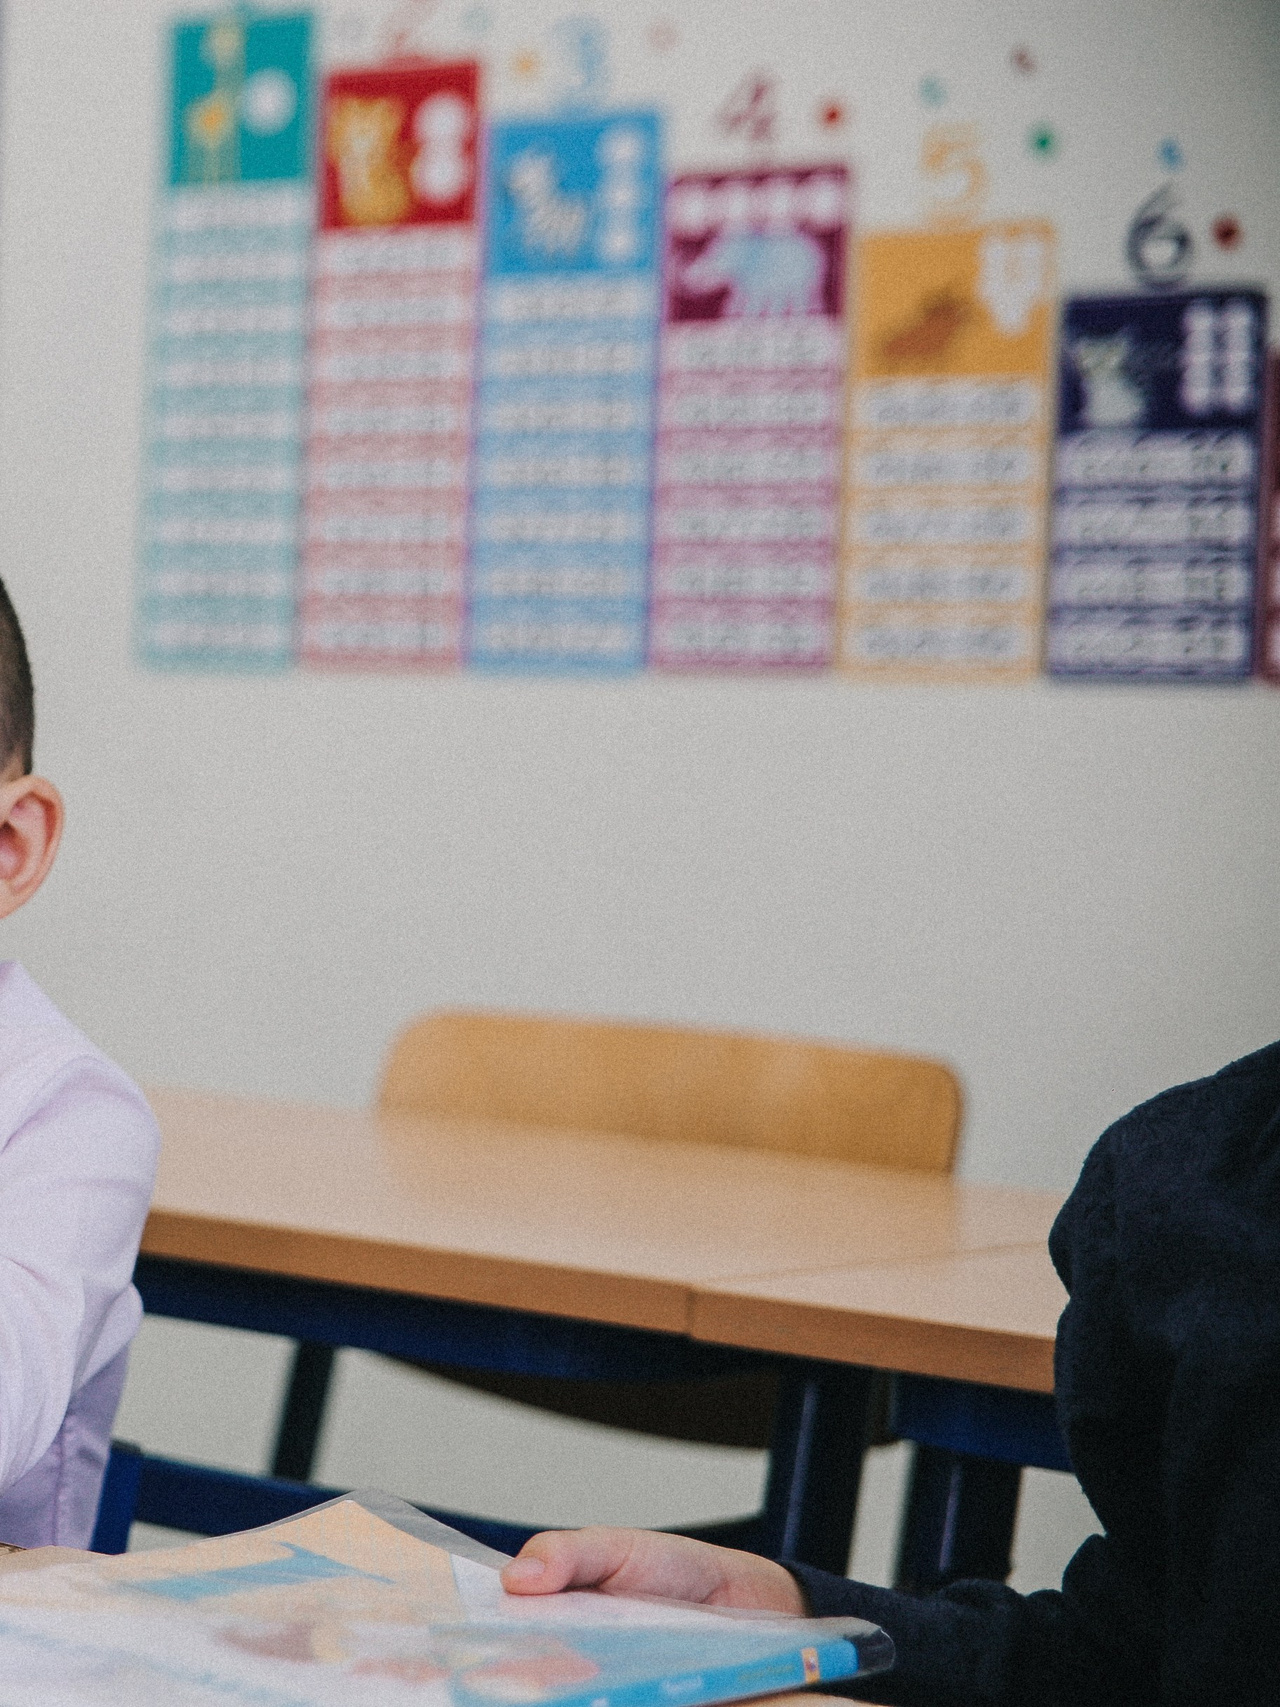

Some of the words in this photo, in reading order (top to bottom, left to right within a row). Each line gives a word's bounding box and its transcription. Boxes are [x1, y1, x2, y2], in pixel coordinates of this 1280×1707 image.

[714, 68, 778, 162] 4
[921, 122, 988, 226] 5
[1123, 183, 1198, 292] 6
